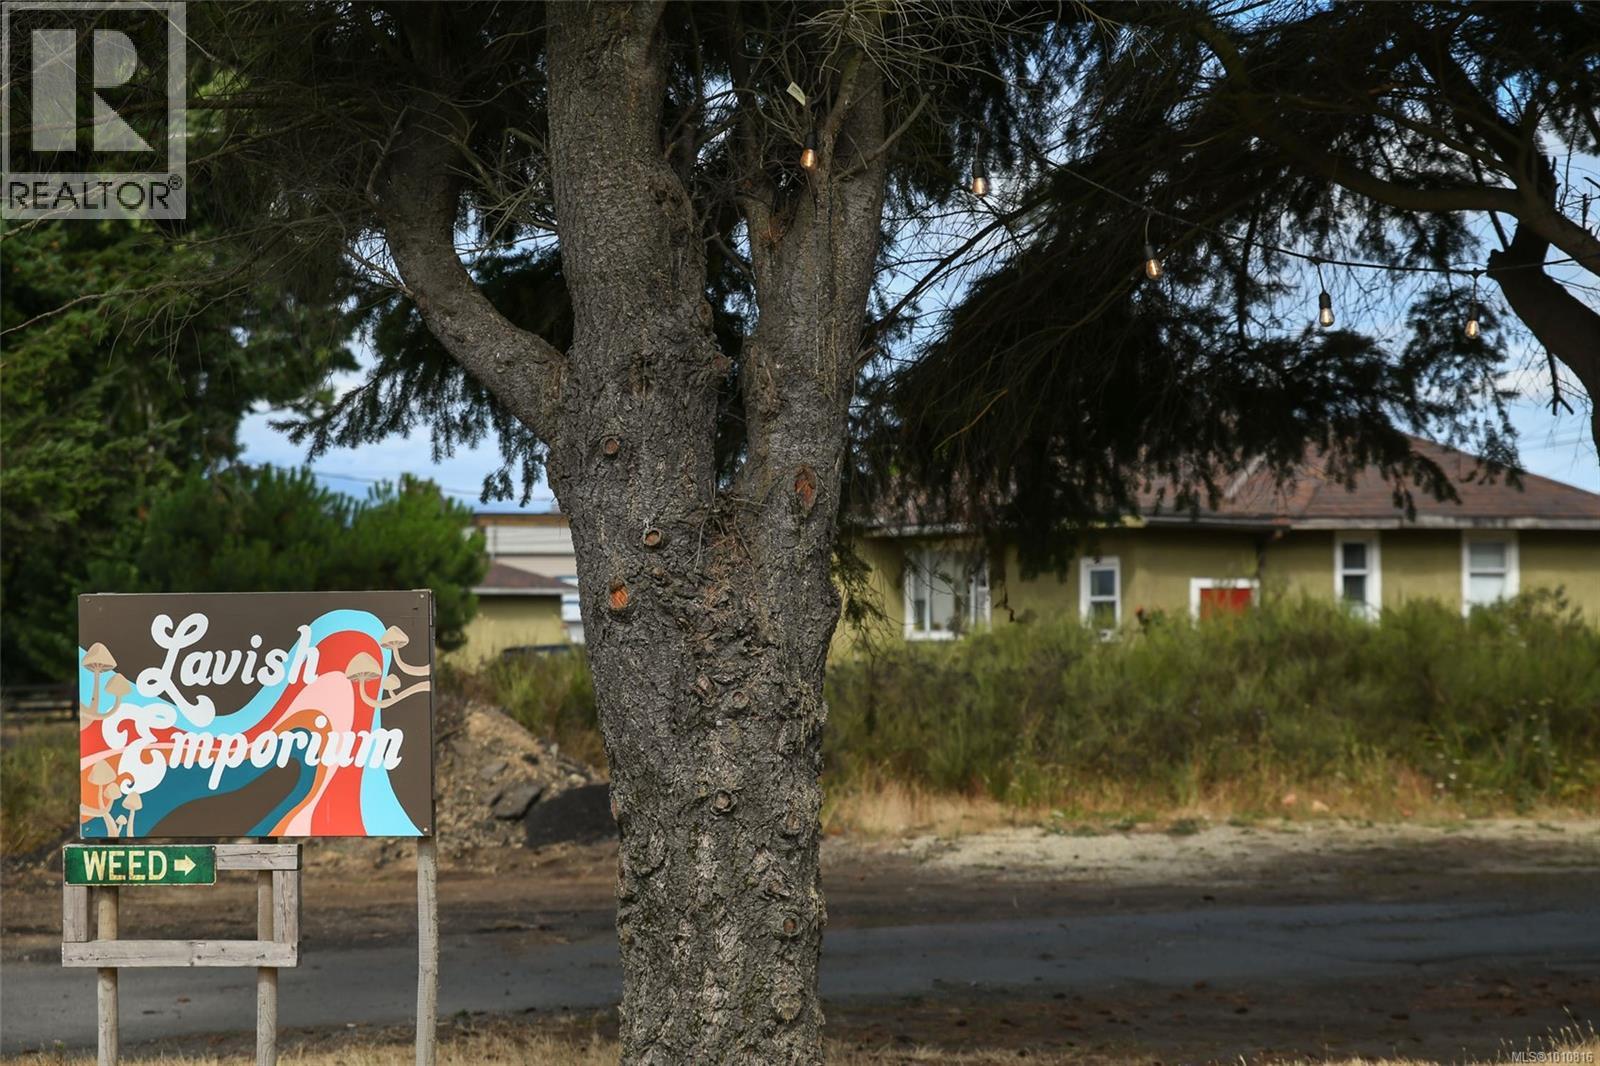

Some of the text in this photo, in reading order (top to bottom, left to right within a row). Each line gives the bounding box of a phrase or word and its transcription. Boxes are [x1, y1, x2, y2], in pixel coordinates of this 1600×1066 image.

[136, 612, 321, 728] Lavish
[101, 703, 404, 795] Emporium
[83, 850, 168, 881] WEED
